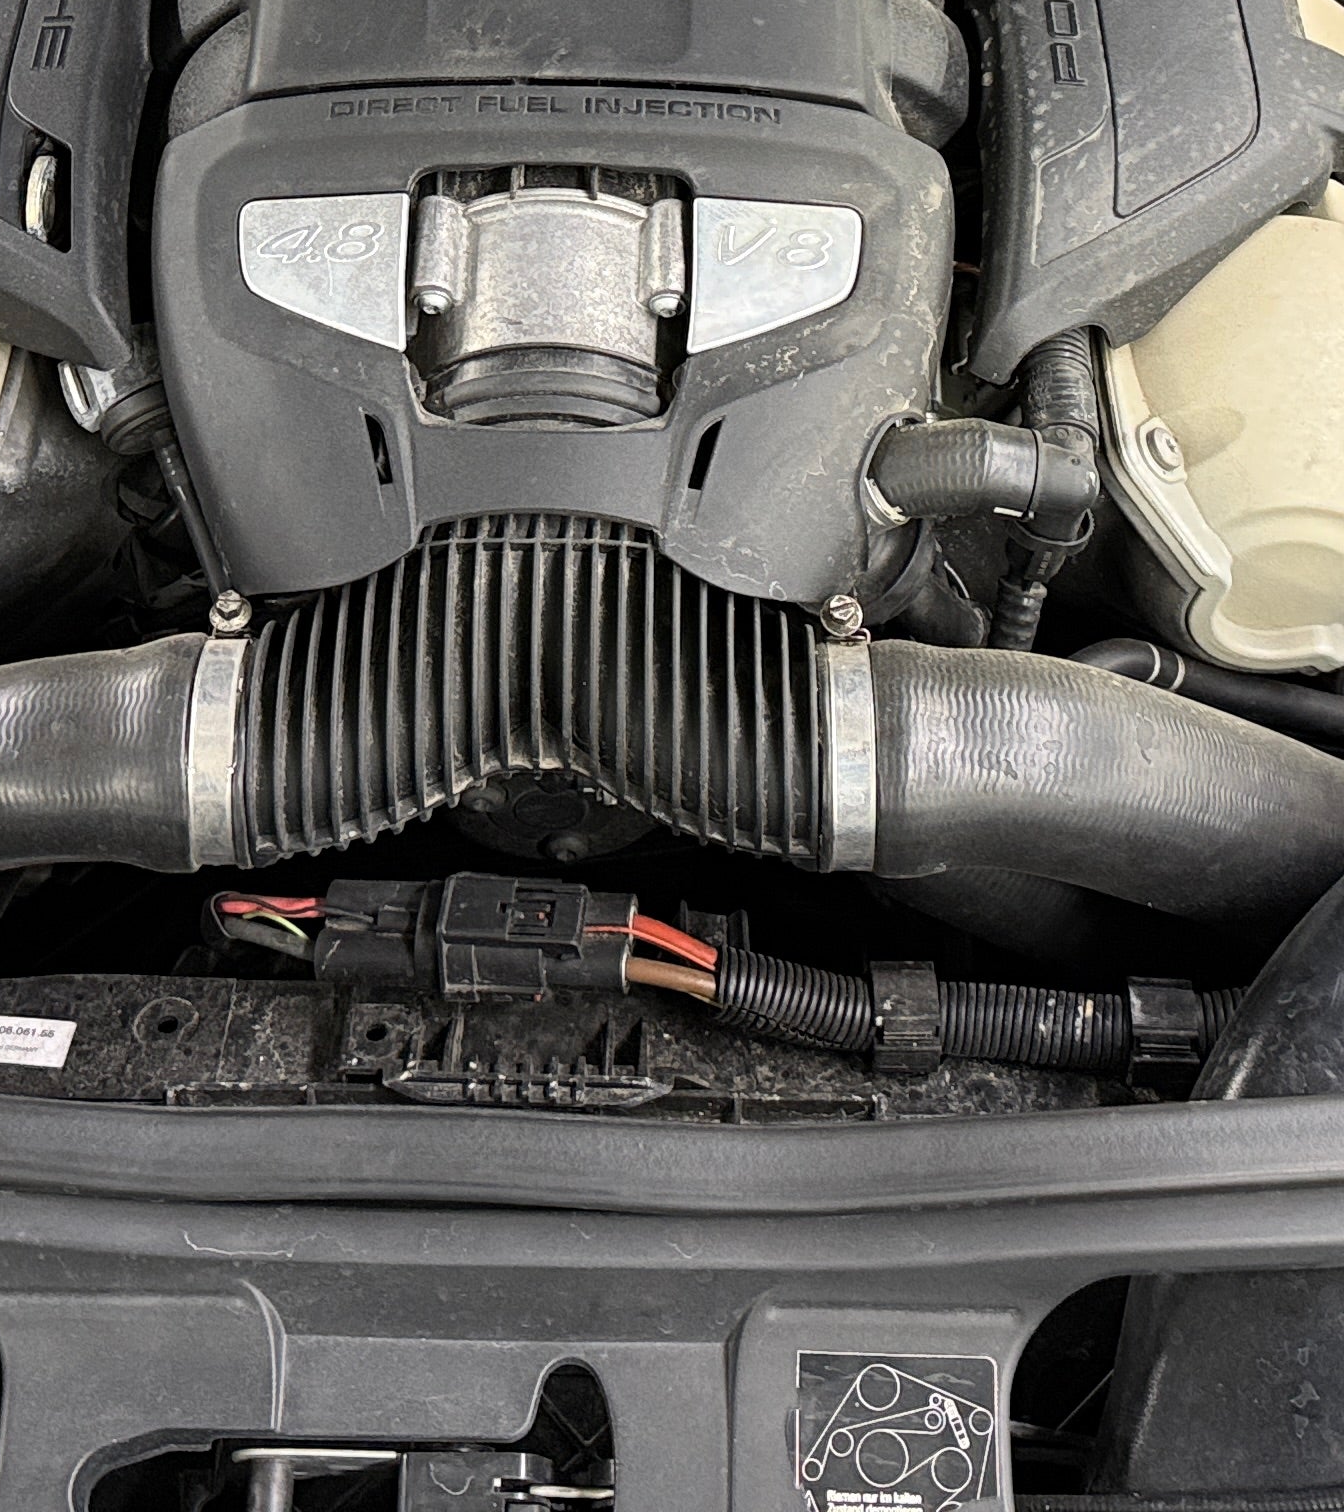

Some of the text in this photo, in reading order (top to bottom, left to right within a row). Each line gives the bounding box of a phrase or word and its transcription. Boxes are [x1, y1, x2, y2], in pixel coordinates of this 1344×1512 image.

[329, 95, 782, 126] DIRECT FUEL INJECTION
[256, 221, 384, 265] 4.8
